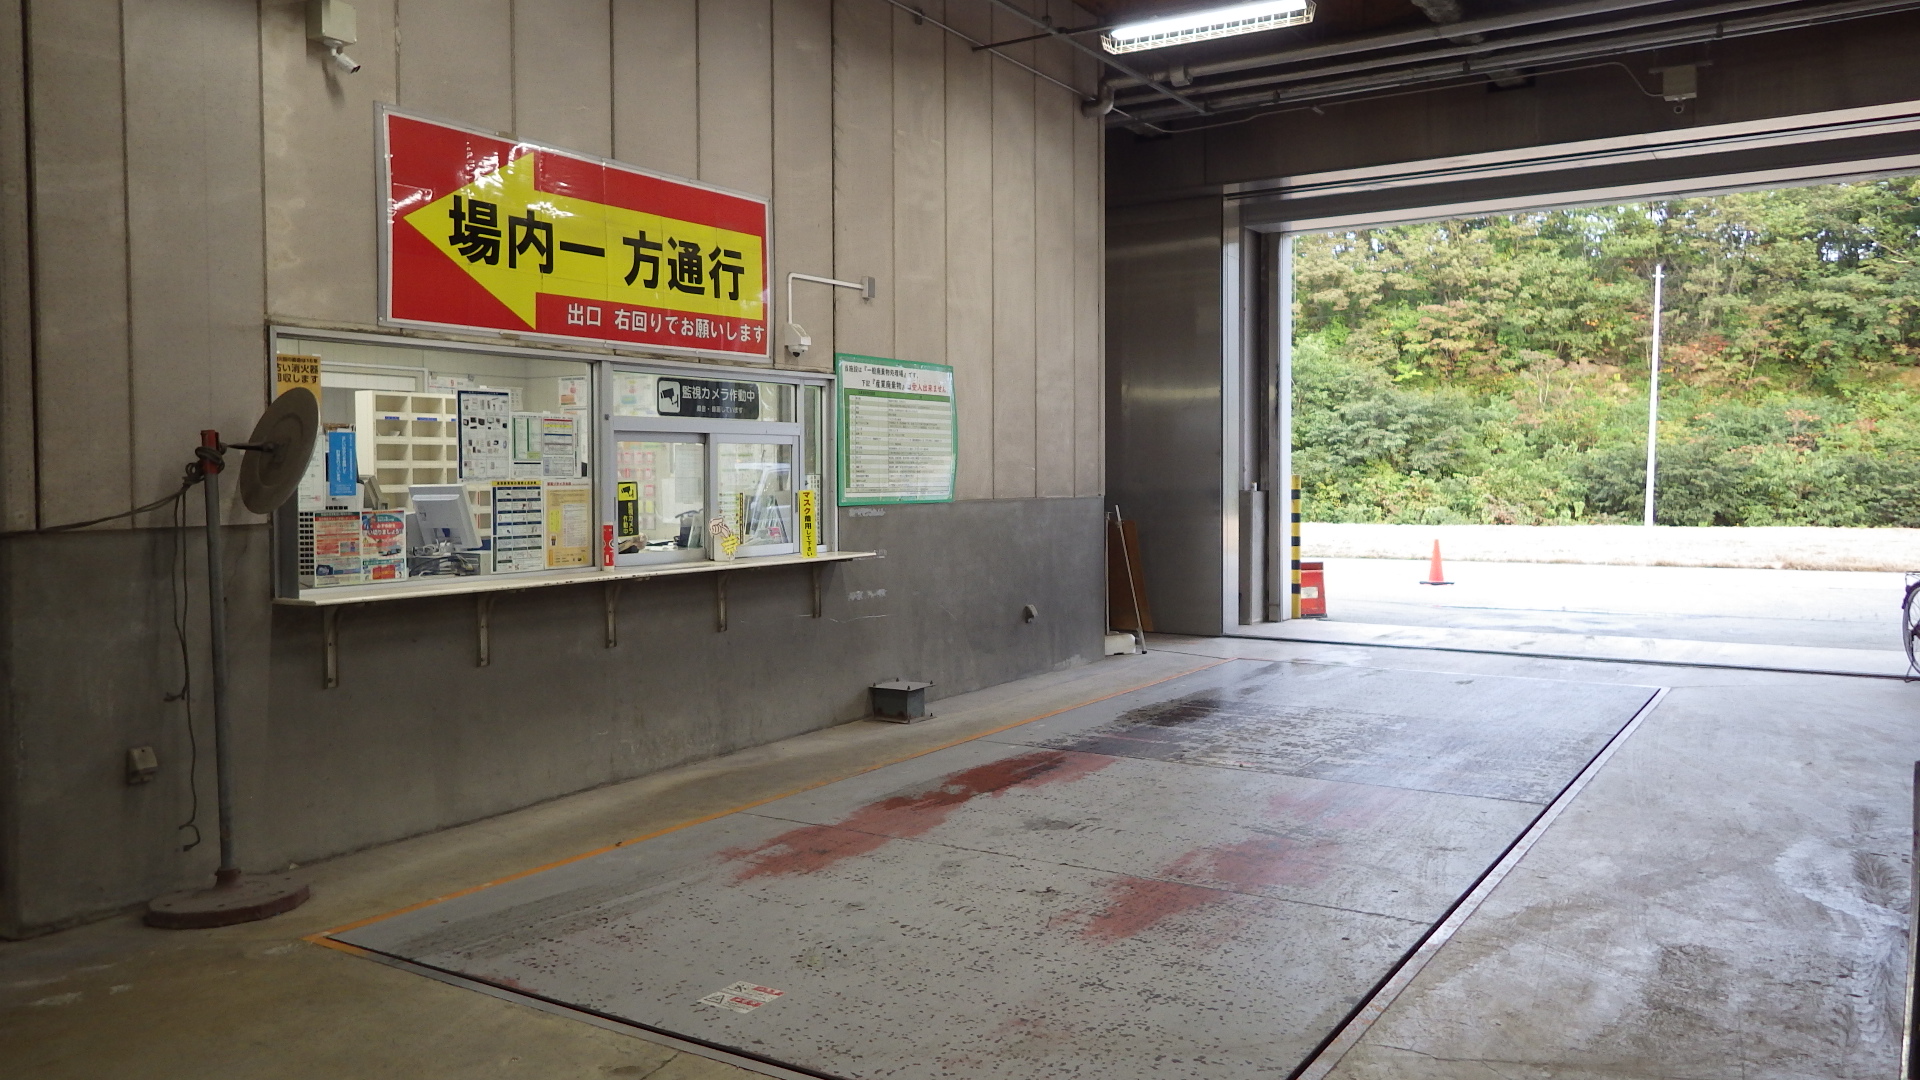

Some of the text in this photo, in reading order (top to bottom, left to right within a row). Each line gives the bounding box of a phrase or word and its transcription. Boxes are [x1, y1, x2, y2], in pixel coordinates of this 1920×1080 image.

[448, 194, 745, 301] 場内一方通行
[567, 303, 765, 343] 出口 右回りでお願いします
[682, 385, 755, 403] 監視カメラ作動中
[802, 491, 812, 557] マスク着用して下さい
